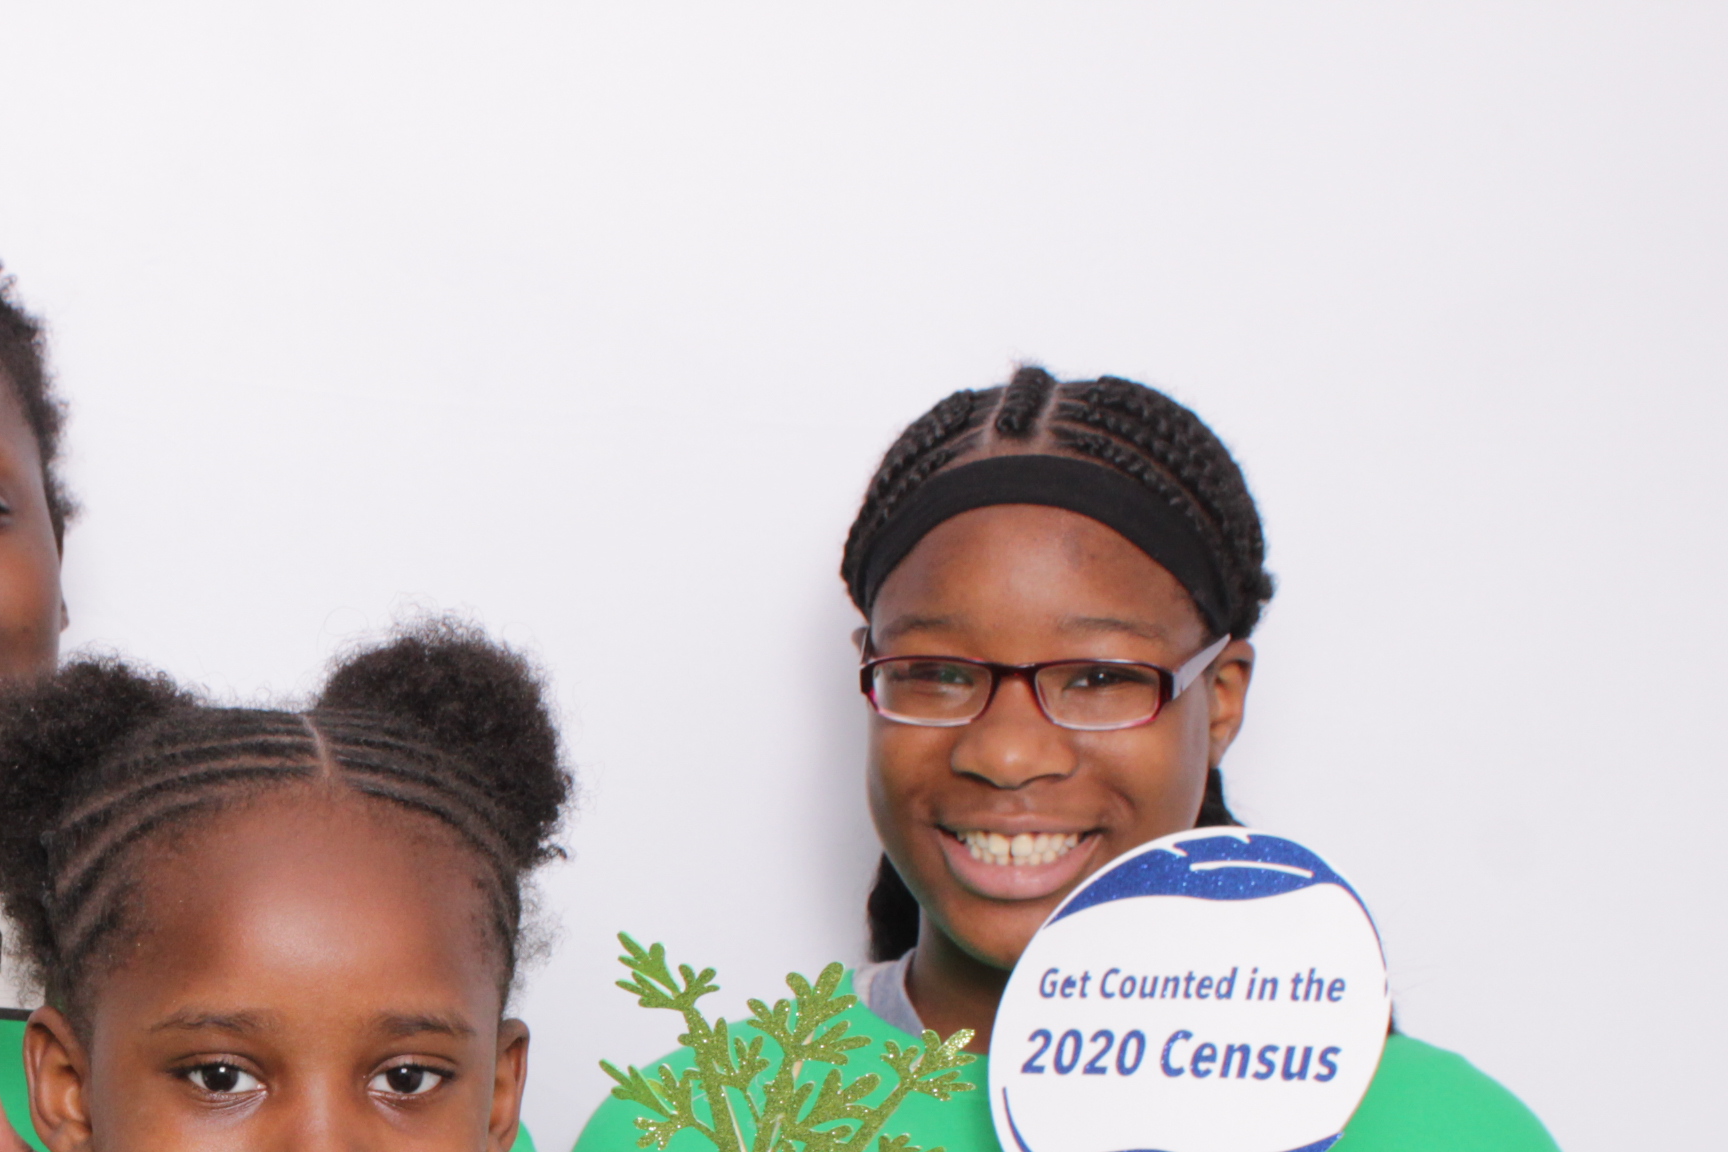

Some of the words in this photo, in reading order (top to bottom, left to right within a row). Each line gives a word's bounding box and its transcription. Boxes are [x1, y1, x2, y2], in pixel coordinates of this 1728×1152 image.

[1039, 968, 1091, 998] Get
[1100, 967, 1238, 1000] Counted
[1246, 967, 1278, 1001] in
[1290, 968, 1345, 1002] the
[1021, 1028, 1146, 1077] 2020
[1161, 1030, 1342, 1083] Census
